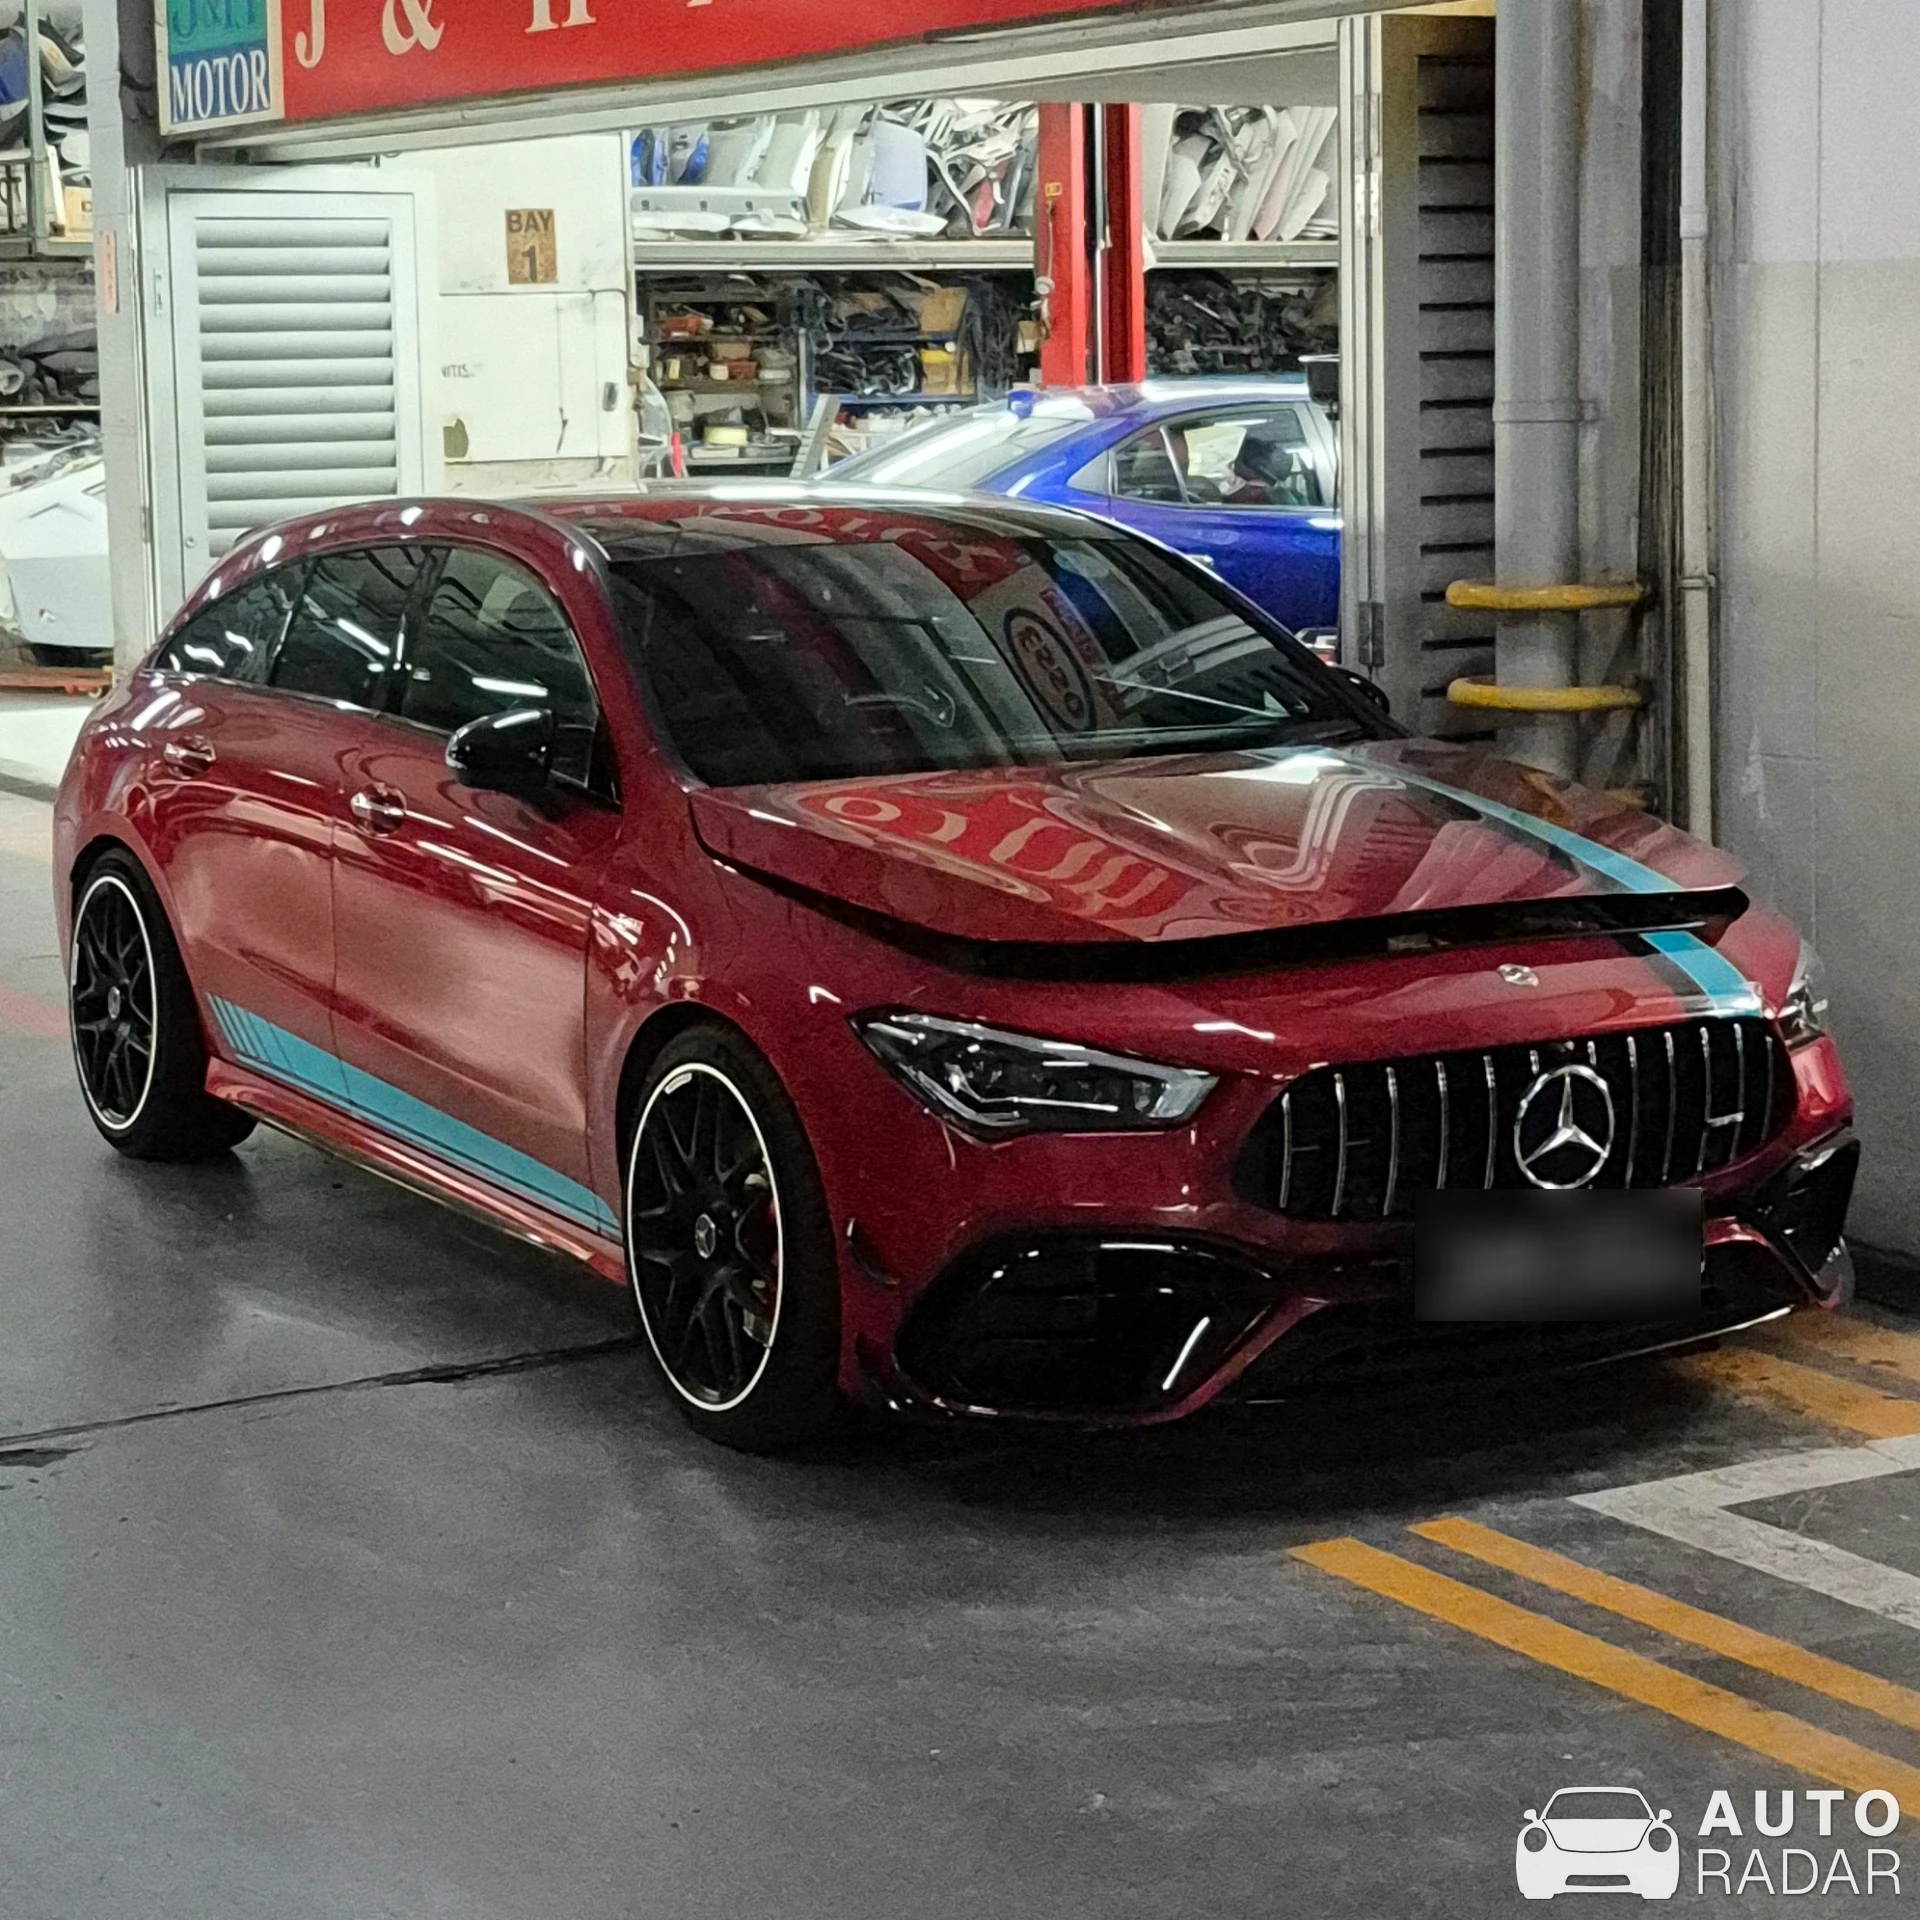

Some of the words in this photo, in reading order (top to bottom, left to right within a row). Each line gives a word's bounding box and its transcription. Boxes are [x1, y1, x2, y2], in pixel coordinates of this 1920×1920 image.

[171, 50, 270, 122] MOTOR
[506, 209, 553, 233] BAY
[521, 245, 537, 283] 1
